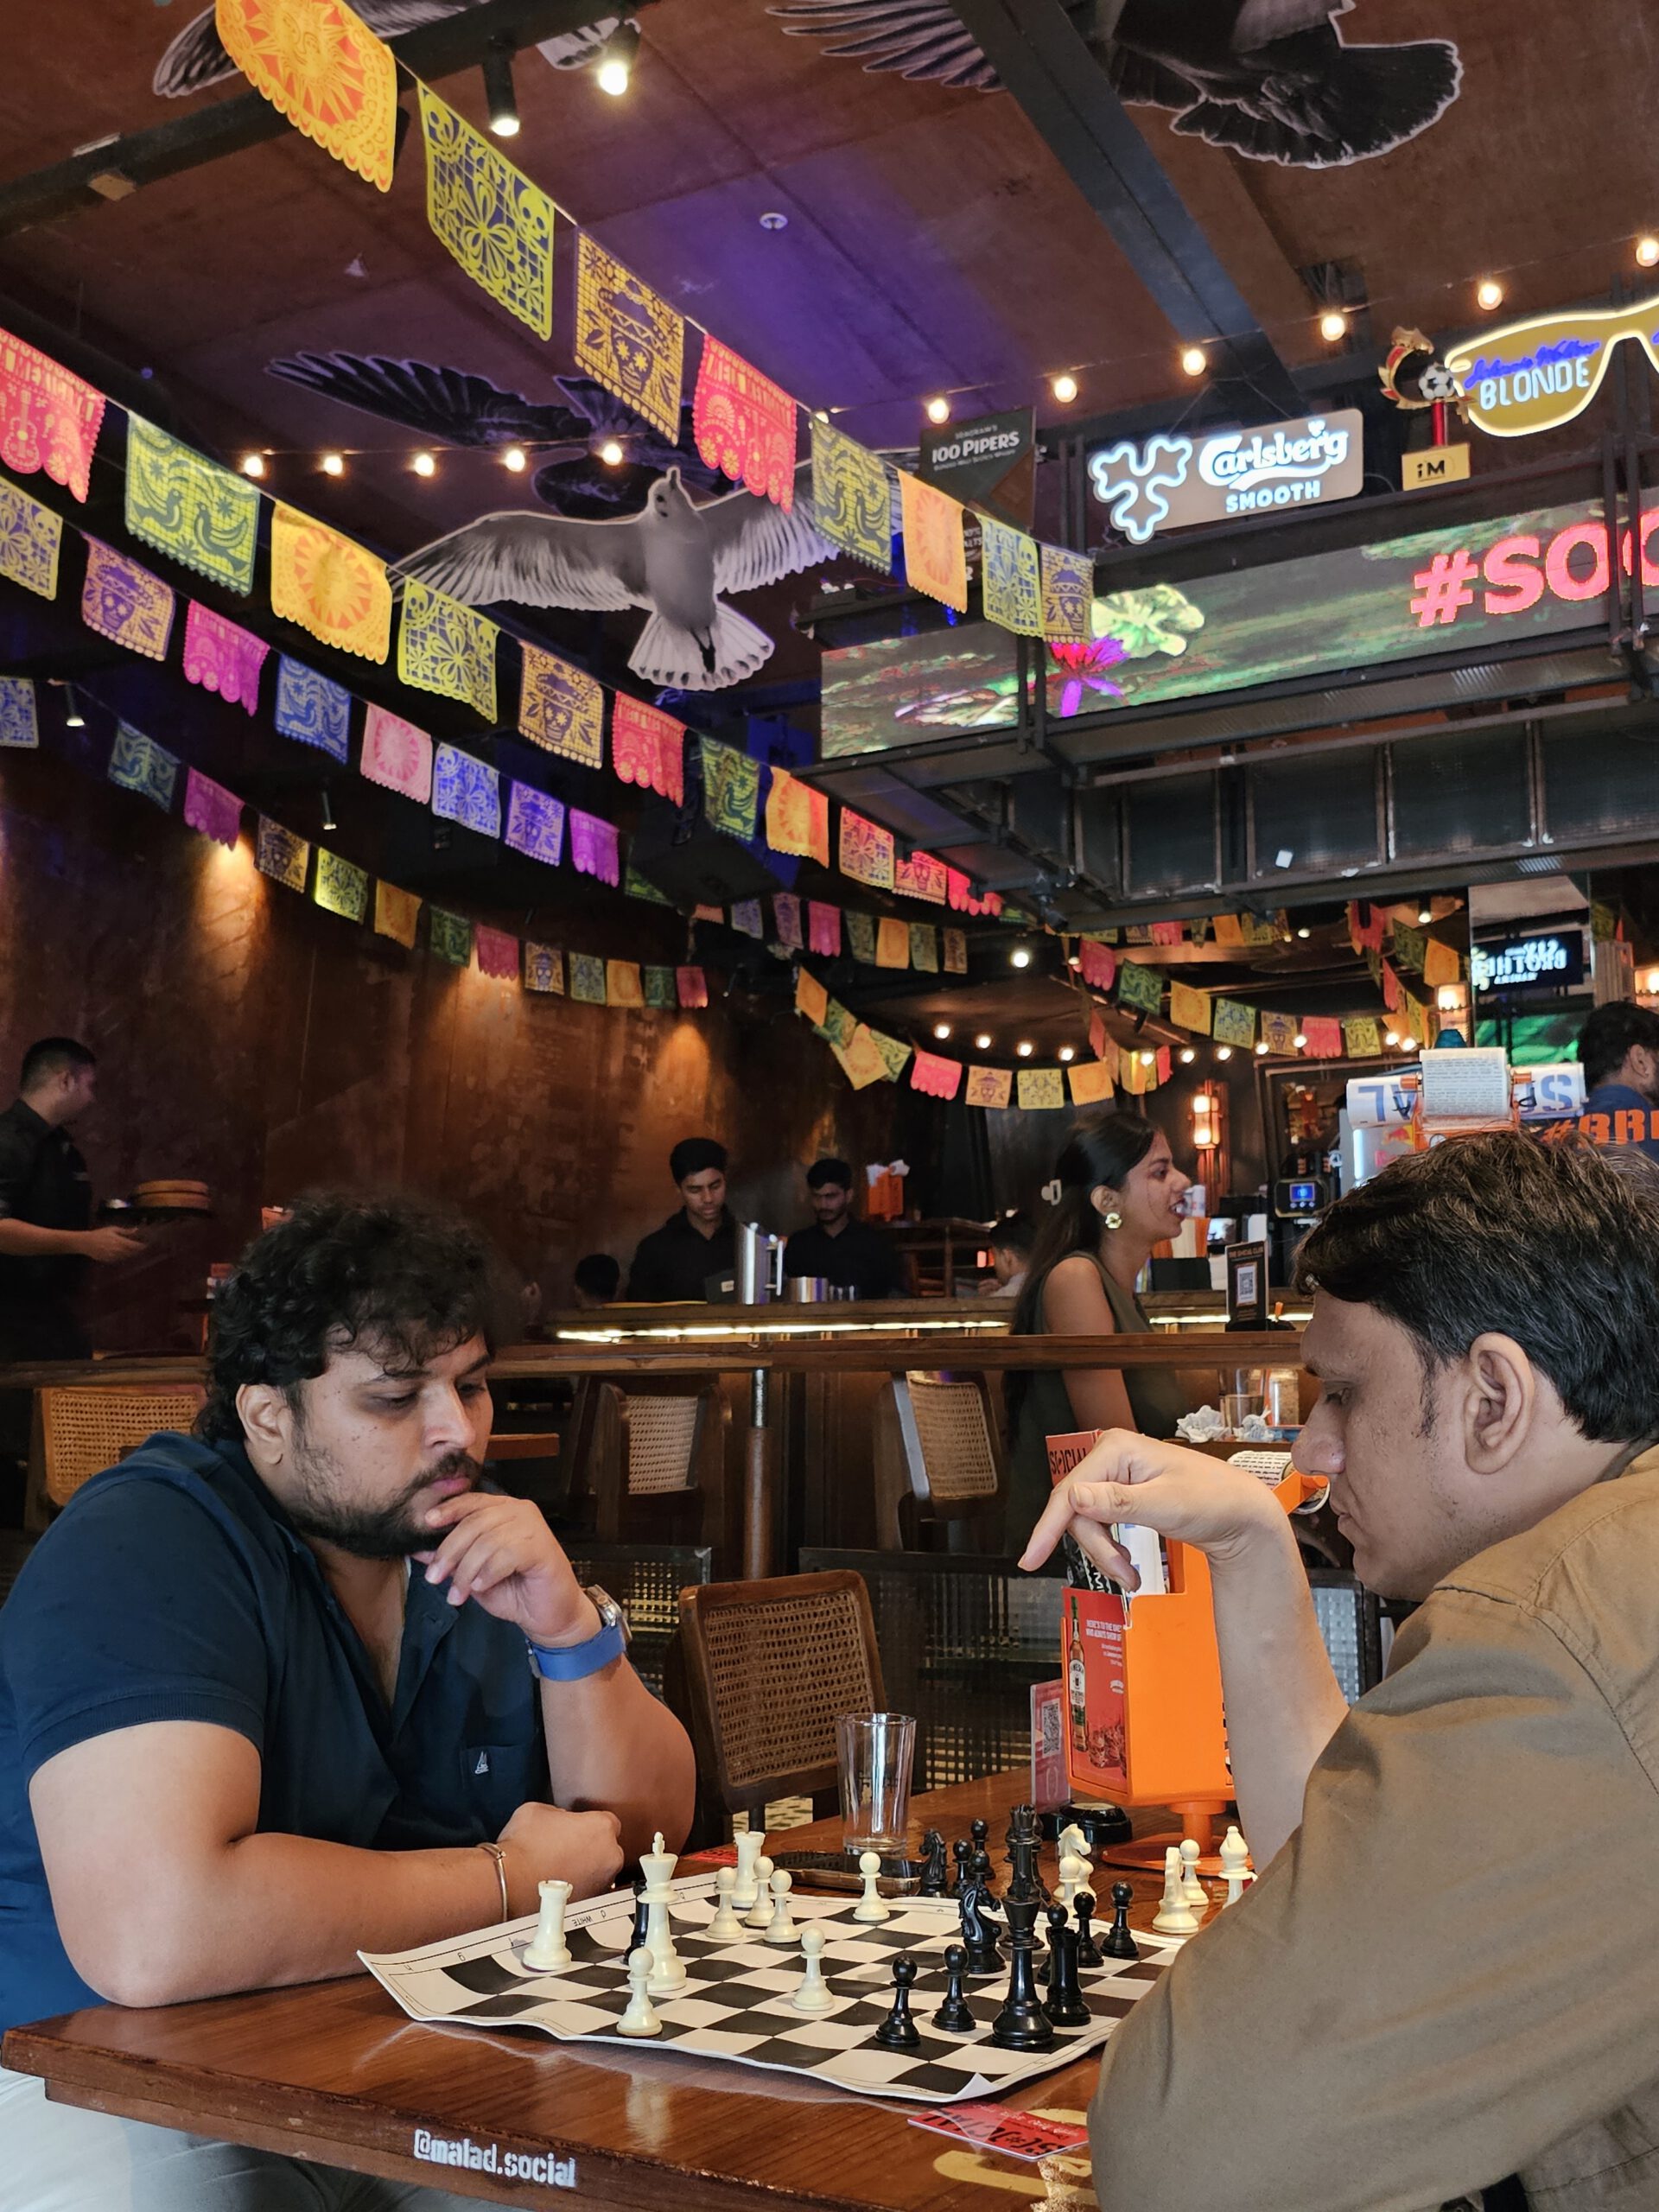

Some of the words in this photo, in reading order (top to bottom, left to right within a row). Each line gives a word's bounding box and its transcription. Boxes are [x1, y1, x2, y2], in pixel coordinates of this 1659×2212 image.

[1480, 355, 1591, 410] BLONDE
[931, 445, 961, 464] 100
[962, 431, 1020, 457] PIPERS
[1198, 419, 1349, 487] Carlsberg
[1225, 480, 1321, 513] SMOOTH
[571, 1915, 594, 1928] WHITE
[413, 2128, 576, 2188] @malad.social
